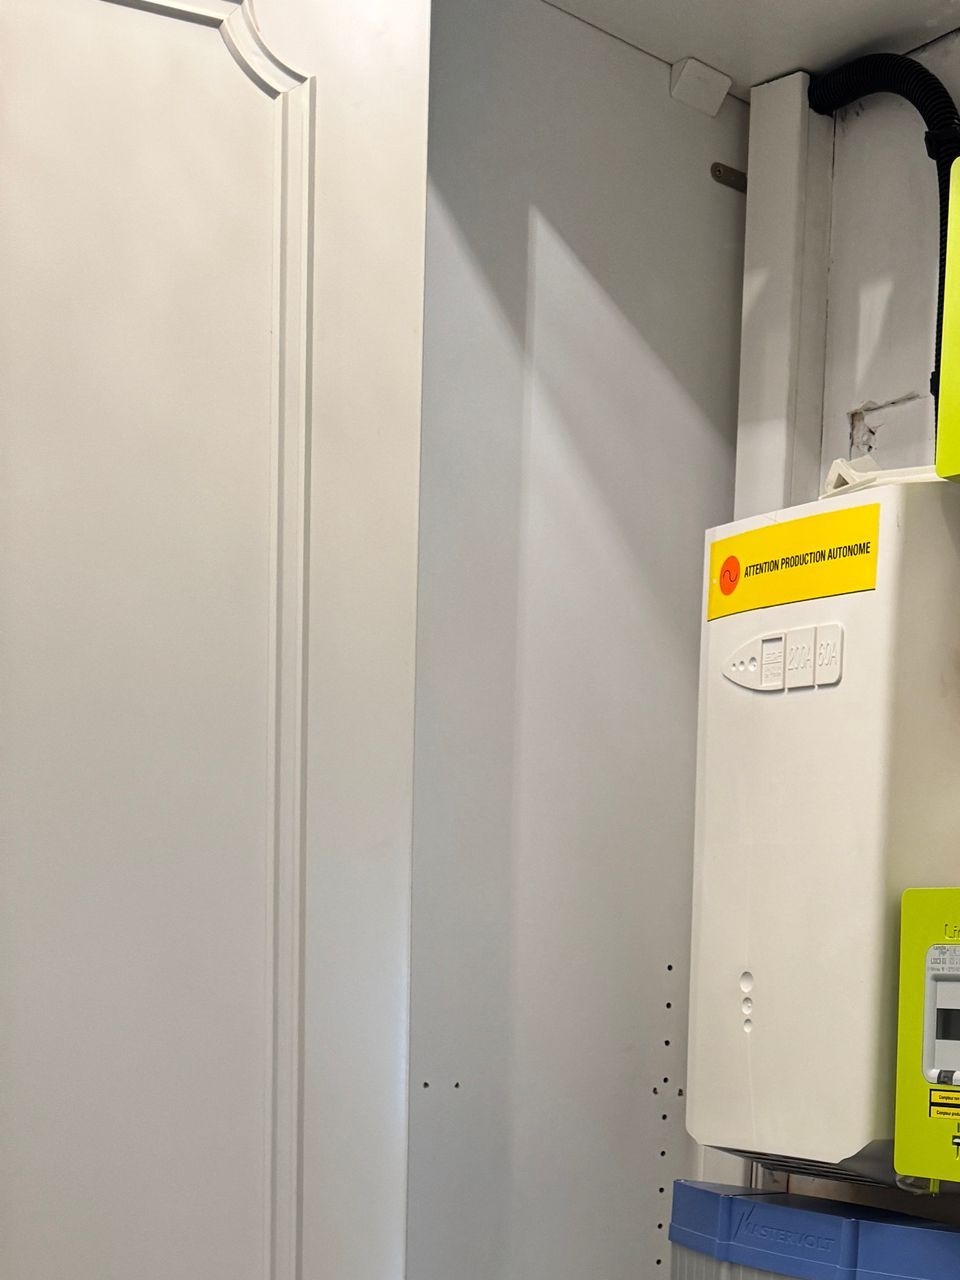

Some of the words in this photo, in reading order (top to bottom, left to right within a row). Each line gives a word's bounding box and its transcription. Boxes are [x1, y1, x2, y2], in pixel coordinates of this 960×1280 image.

[744, 559, 779, 578] ATTENTION
[781, 550, 825, 570] PRODUCTION
[827, 541, 871, 560] AUTONOME
